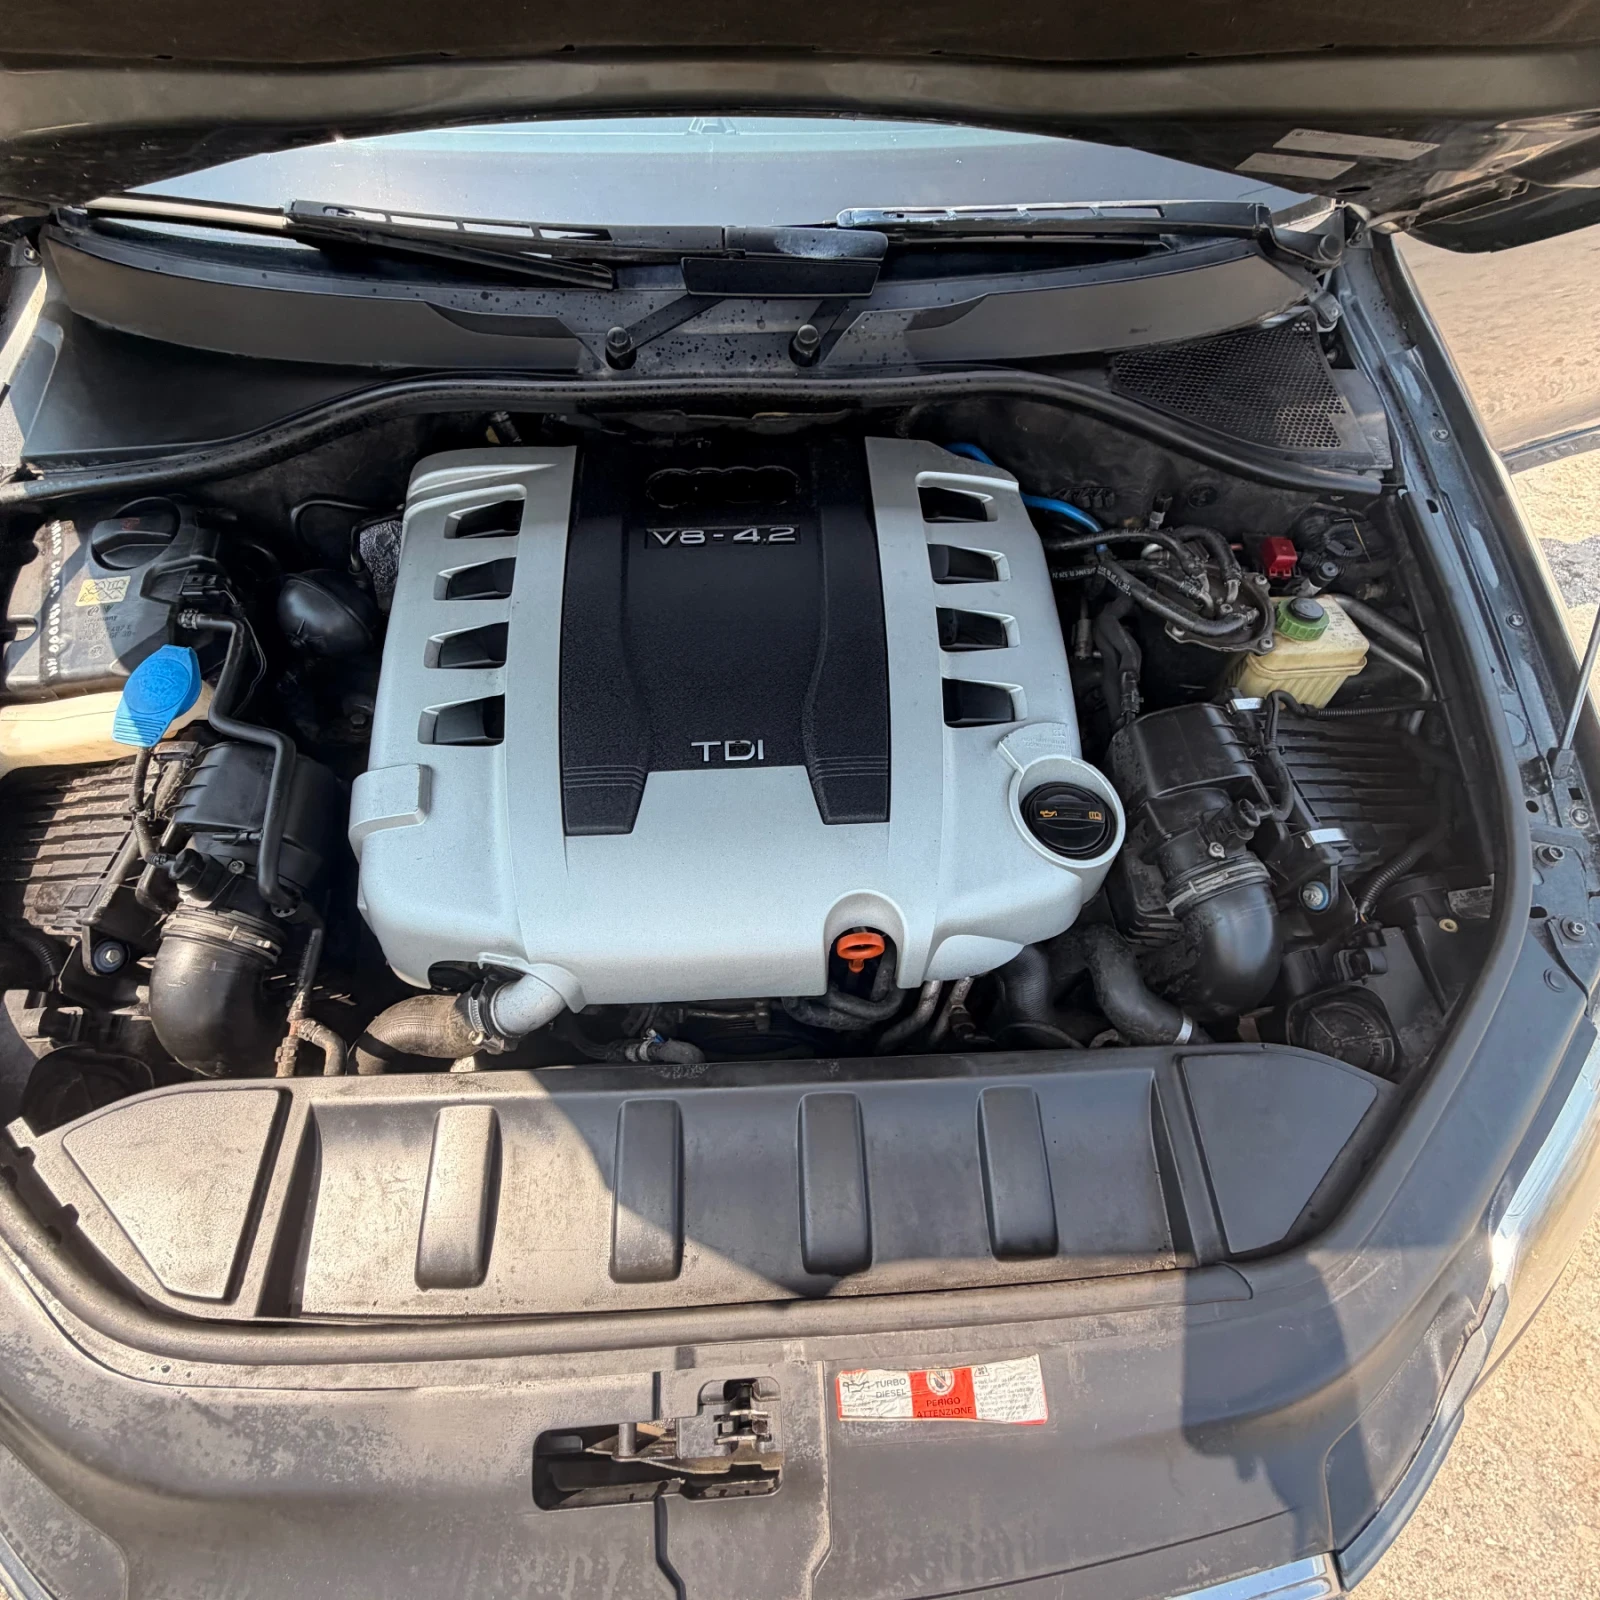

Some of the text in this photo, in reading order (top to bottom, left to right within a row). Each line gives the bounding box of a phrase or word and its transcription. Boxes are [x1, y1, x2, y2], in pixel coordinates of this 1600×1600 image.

[652, 529, 706, 545] V8
[732, 526, 796, 543] 4.2
[691, 739, 764, 761] TDI
[875, 1378, 907, 1389] TURBO
[875, 1388, 907, 1399] DIESEL
[926, 1396, 961, 1407] PERIGO
[916, 1406, 973, 1418] ATTENZIONE
